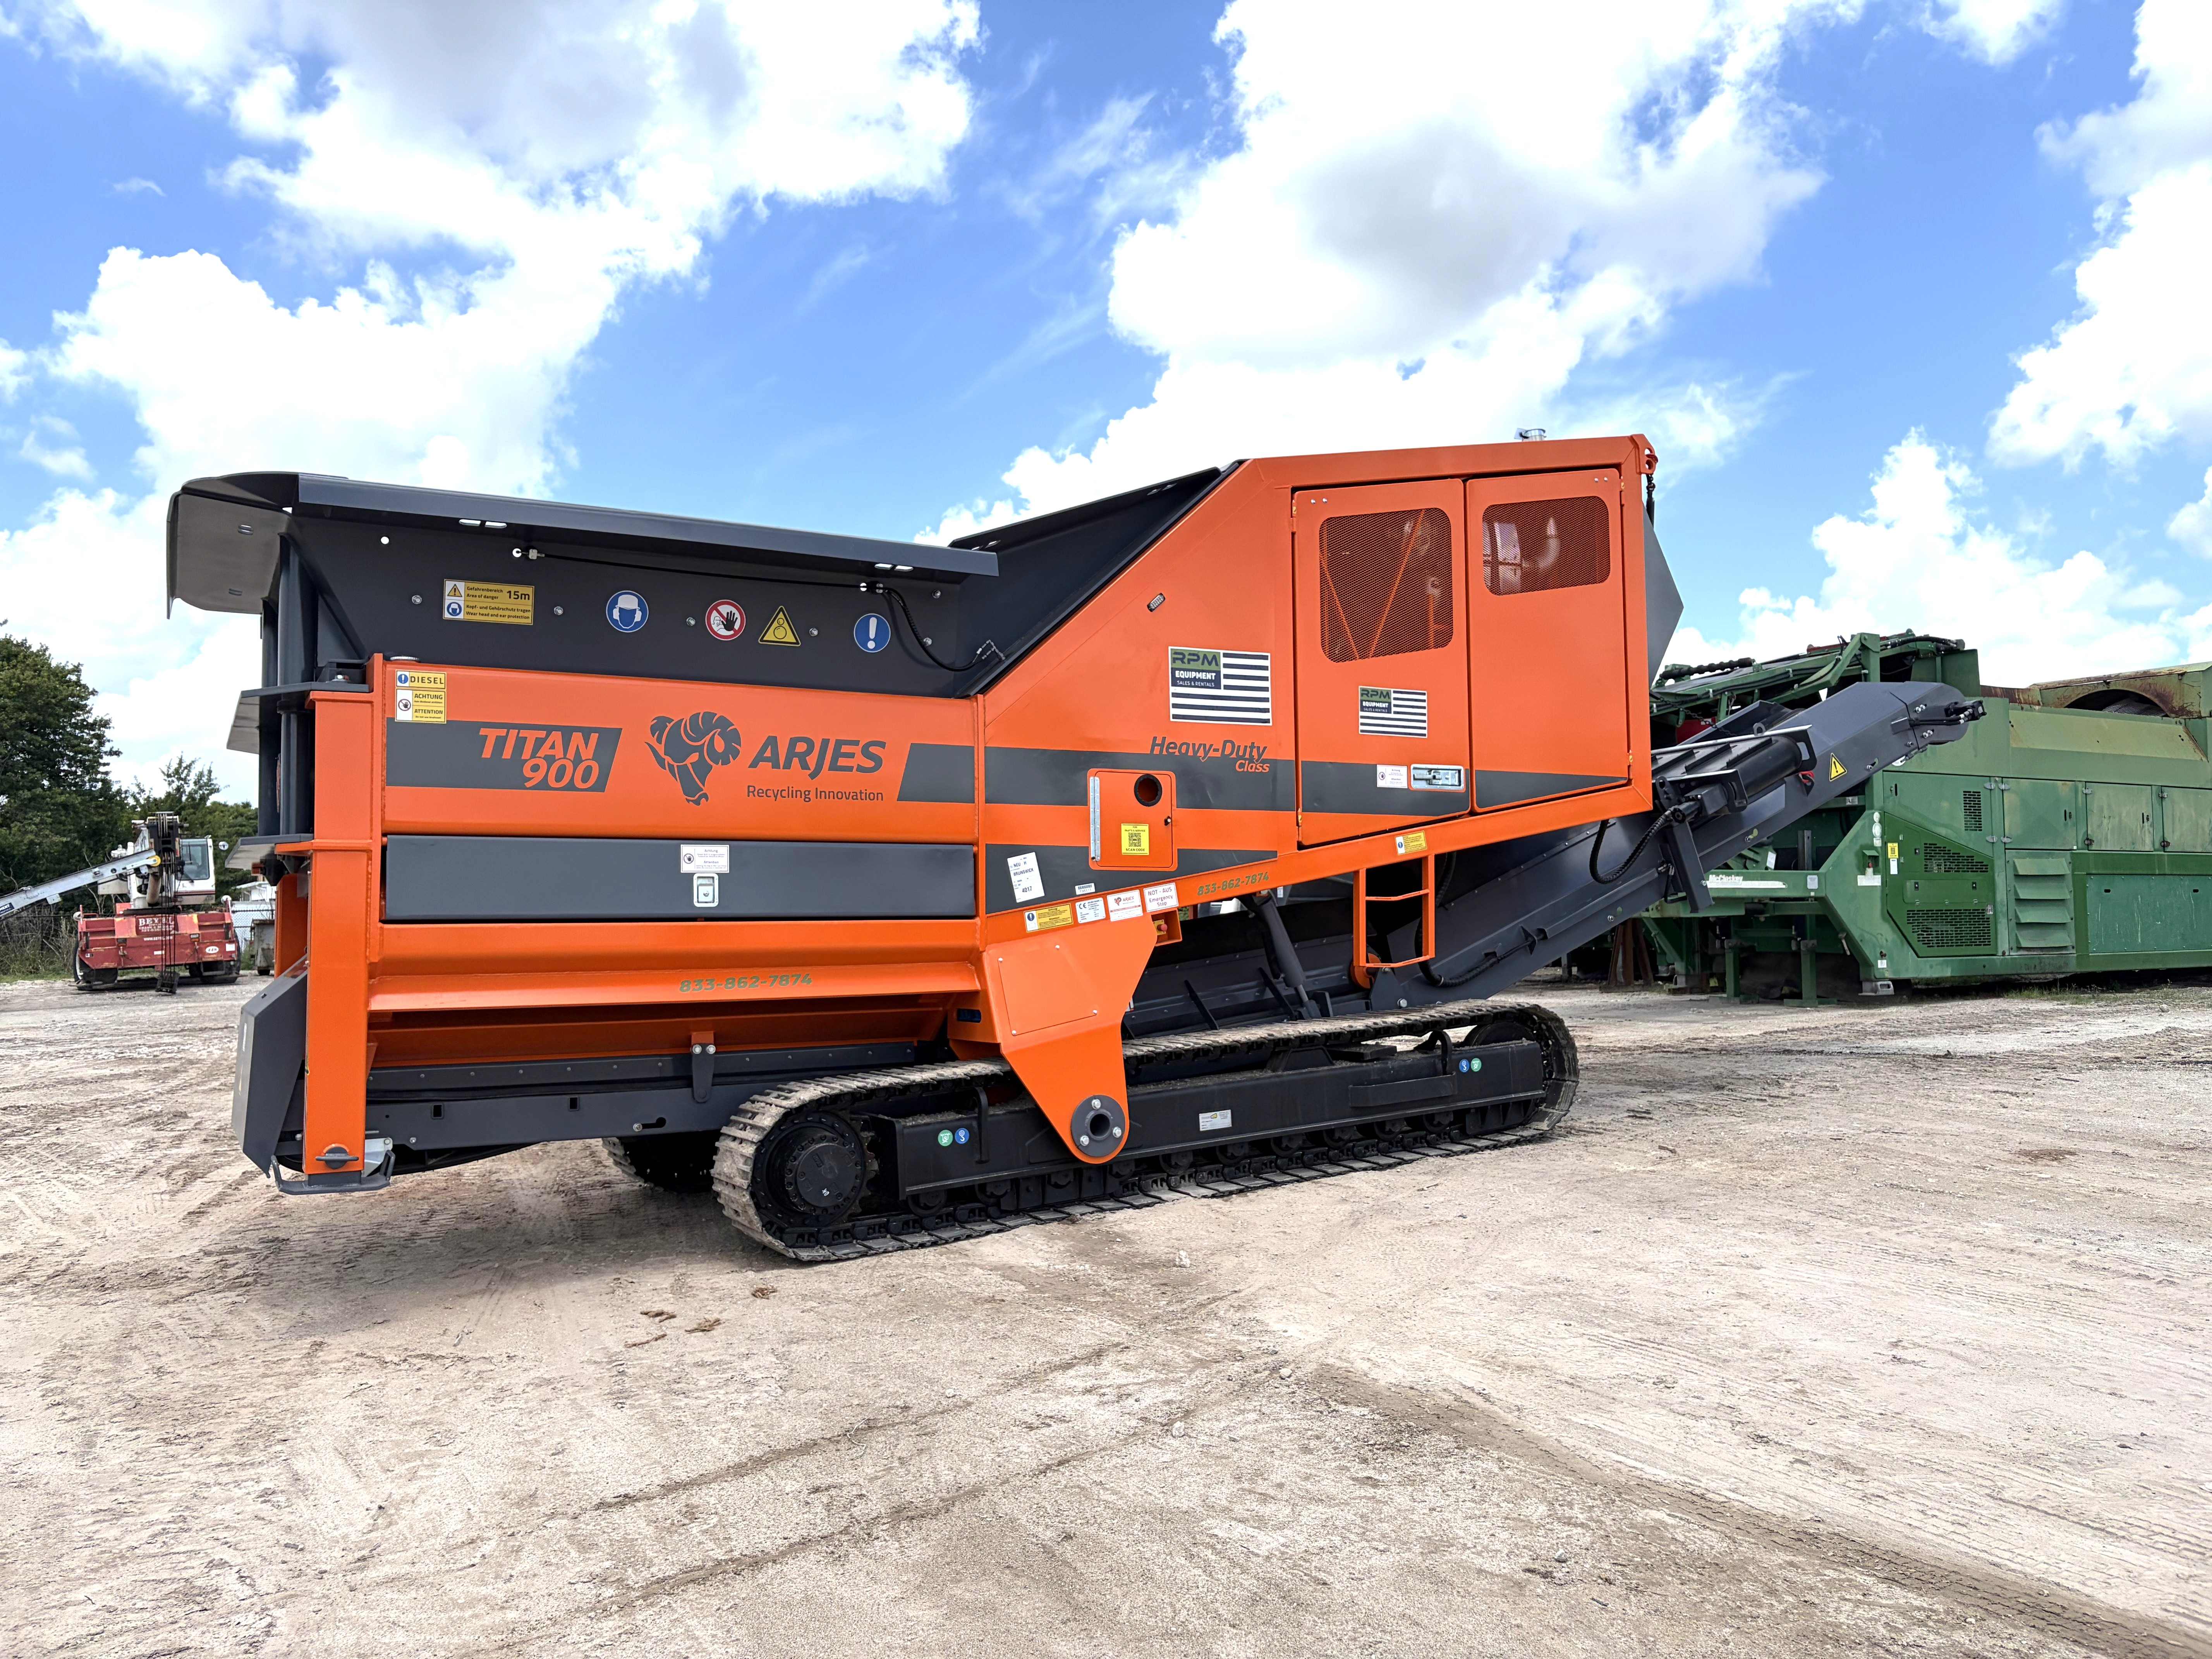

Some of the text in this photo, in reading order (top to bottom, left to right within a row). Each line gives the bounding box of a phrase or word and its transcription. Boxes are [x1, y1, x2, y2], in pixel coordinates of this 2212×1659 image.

[507, 590, 530, 600] 15m
[1172, 651, 1219, 666] RPM
[410, 676, 444, 684] DIESEL
[1175, 670, 1216, 680] EQUIPMENT
[1361, 689, 1390, 699] RPM
[479, 728, 599, 761] TITAN
[1150, 736, 1267, 764] Heavy-Duty
[748, 735, 886, 780] ARJES
[523, 757, 599, 789] 900
[1235, 760, 1270, 773] Class
[747, 785, 883, 802] Recycling Innovation
[1197, 871, 1269, 895] 833-862-7874
[679, 973, 812, 992] 833-862-7874
